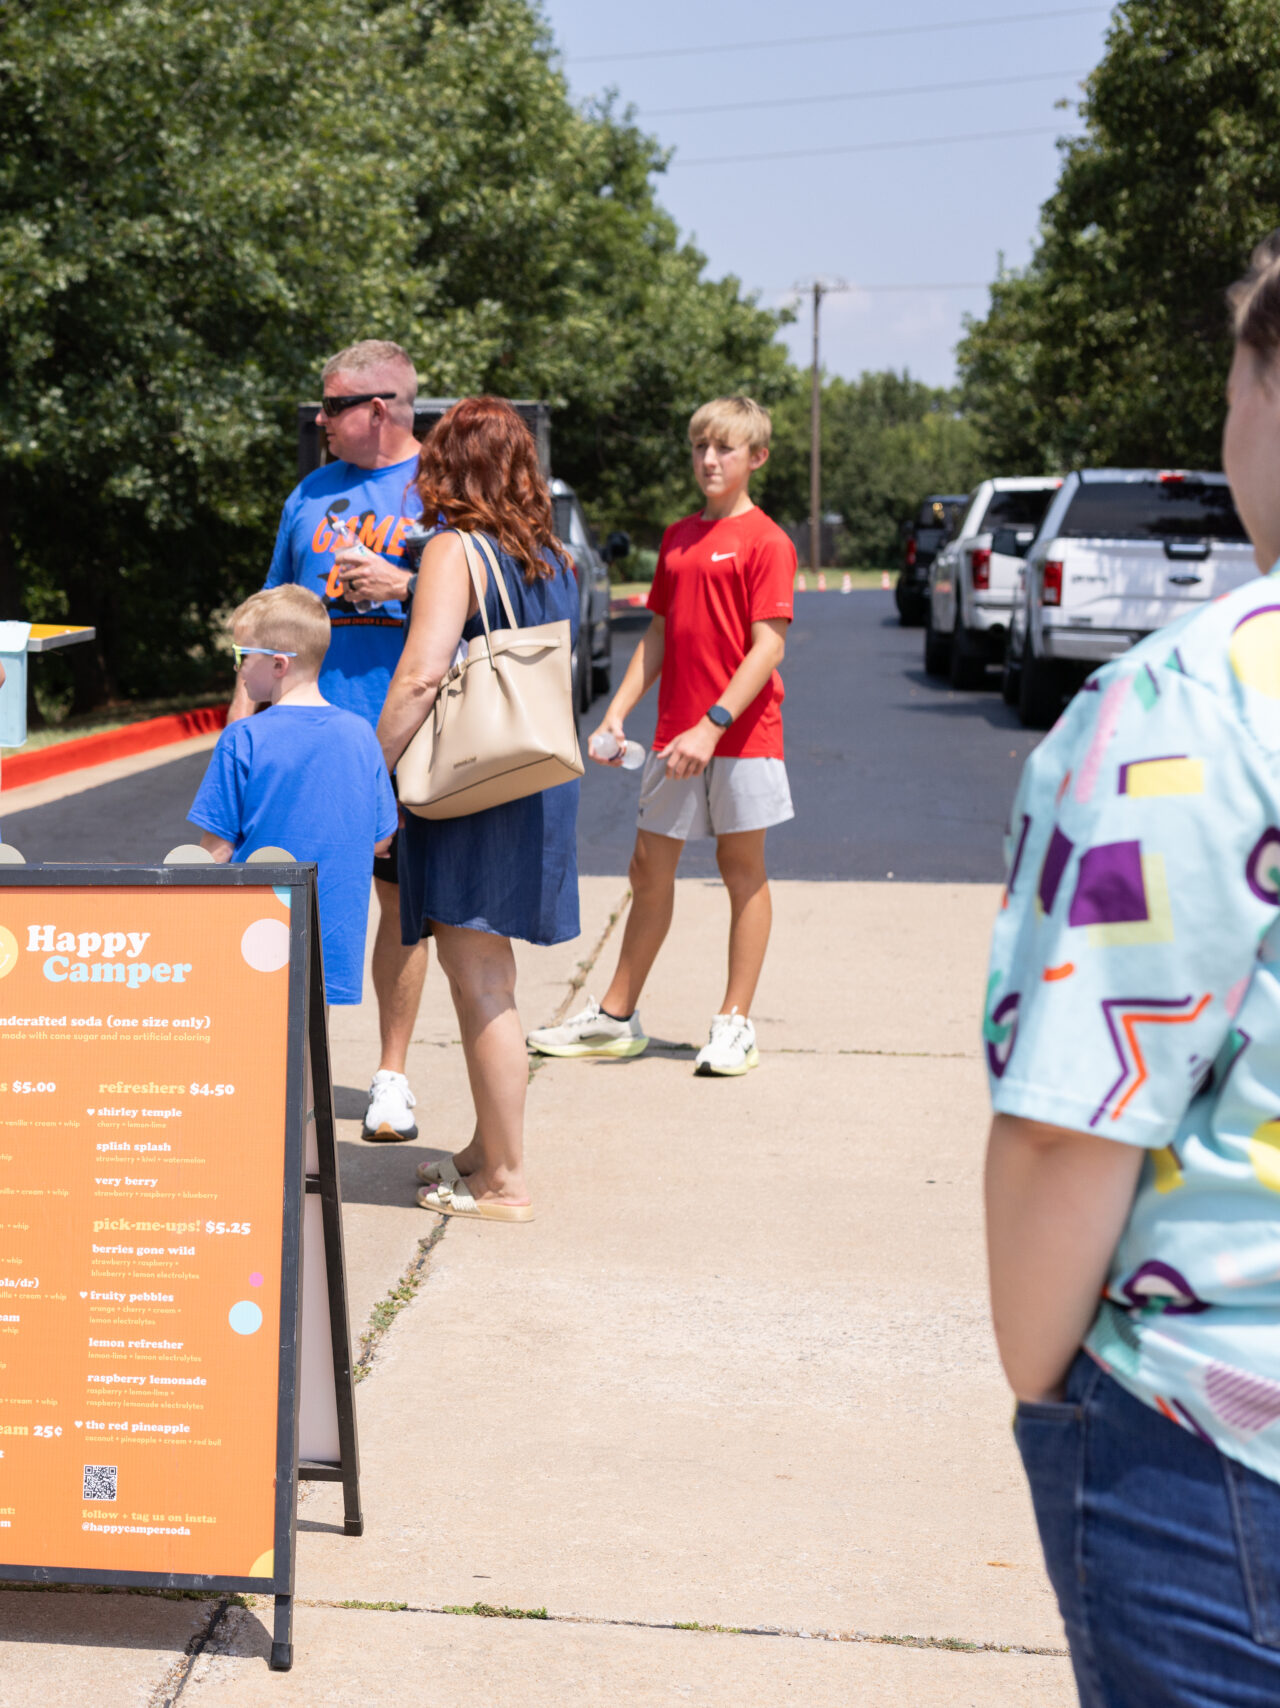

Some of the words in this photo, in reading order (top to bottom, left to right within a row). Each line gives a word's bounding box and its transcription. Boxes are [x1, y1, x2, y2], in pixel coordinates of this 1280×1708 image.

[26, 924, 151, 959] Happy
[43, 954, 192, 989] Camper
[70, 1016, 102, 1027] soda
[107, 1015, 138, 1028] (one
[142, 1017, 169, 1027] size
[172, 1016, 211, 1030] only)
[2, 1031, 27, 1039] made
[29, 1031, 47, 1040] with
[74, 1034, 98, 1042] sugar
[100, 1031, 118, 1040] and
[133, 1032, 171, 1040] artificial
[174, 1032, 211, 1044] coloring
[12, 1080, 56, 1094] $5.00
[99, 1081, 186, 1094] refreshers
[190, 1082, 235, 1096] $4.50
[98, 1107, 138, 1118] shirley
[141, 1108, 182, 1119] temple
[64, 1120, 80, 1128] whip
[97, 1120, 120, 1129] cherry
[96, 1141, 130, 1152] splish
[134, 1142, 171, 1153] splash
[96, 1154, 135, 1164] strawberry
[94, 1178, 122, 1187] very
[124, 1176, 158, 1187] berry
[52, 1189, 70, 1197] whip
[94, 1189, 133, 1198] strawberry
[139, 1190, 176, 1200] raspberry
[183, 1191, 218, 1200] blueberry
[93, 1218, 202, 1233] pick-me-ups!
[205, 1220, 251, 1235] $5.25
[92, 1244, 134, 1254] berries
[136, 1247, 164, 1256] gone
[168, 1246, 195, 1255] wild
[6, 1256, 22, 1265] whip
[91, 1257, 130, 1267] strawberry
[138, 1259, 173, 1268] raspberry
[91, 1269, 125, 1278] blueberry
[157, 1272, 200, 1280] electrolytes
[90, 1290, 126, 1302] fruity
[129, 1292, 174, 1303] pebbles
[122, 1305, 146, 1314] cherry
[113, 1317, 155, 1326] electrolytes
[2, 1326, 19, 1335] whip
[88, 1337, 125, 1348] lemon
[128, 1339, 184, 1349] refresher
[135, 1352, 156, 1360] lemon
[158, 1354, 201, 1363] electrolytes
[87, 1373, 146, 1385] raspberry
[149, 1375, 207, 1386] lemonade
[87, 1387, 122, 1396] raspberry
[129, 1388, 168, 1396] lemon-lime
[41, 1398, 58, 1407] whip
[86, 1399, 121, 1408] raspberry
[160, 1401, 204, 1410] electrolytes
[33, 1425, 62, 1438] 25¢
[85, 1420, 105, 1430] the
[108, 1421, 128, 1431] red
[131, 1422, 190, 1435] pineapple
[121, 1436, 157, 1444] pineapple
[164, 1437, 186, 1445] cream
[82, 1510, 118, 1519] follow
[132, 1512, 149, 1522] tag
[168, 1515, 182, 1523] on
[185, 1514, 216, 1523] insta:
[82, 1522, 191, 1536] @happycampersoda
